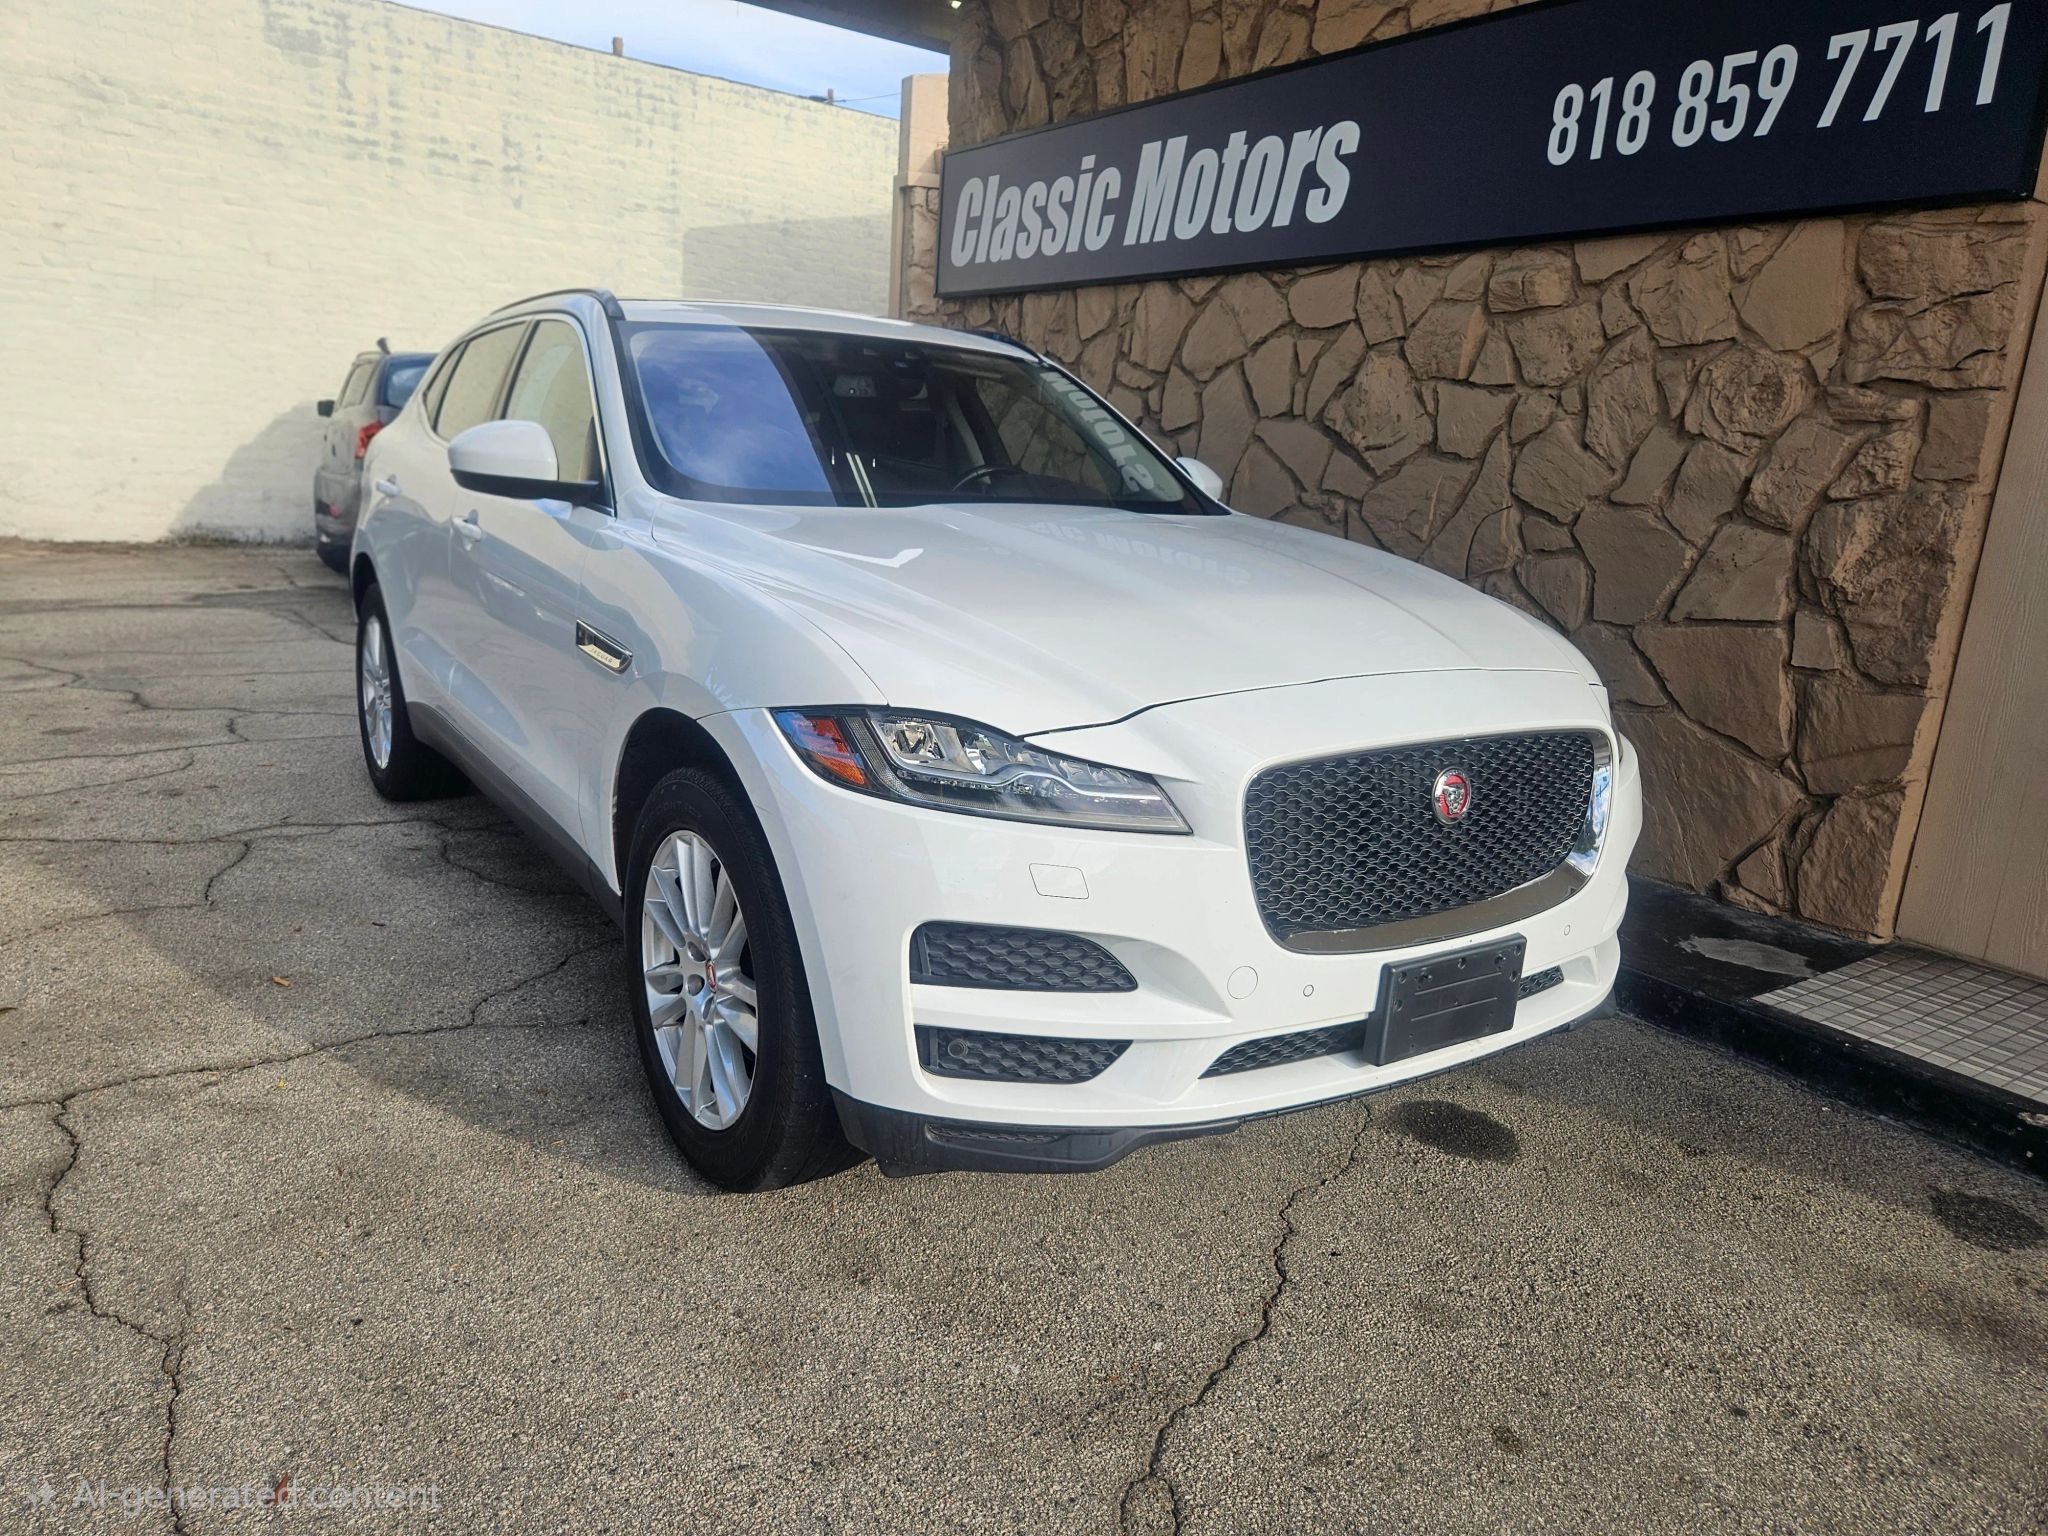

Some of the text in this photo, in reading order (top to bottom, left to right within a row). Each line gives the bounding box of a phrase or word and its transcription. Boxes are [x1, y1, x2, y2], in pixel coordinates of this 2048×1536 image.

[1547, 2, 2012, 166] 818 859 7711
[950, 120, 1361, 267] Classic Motors
